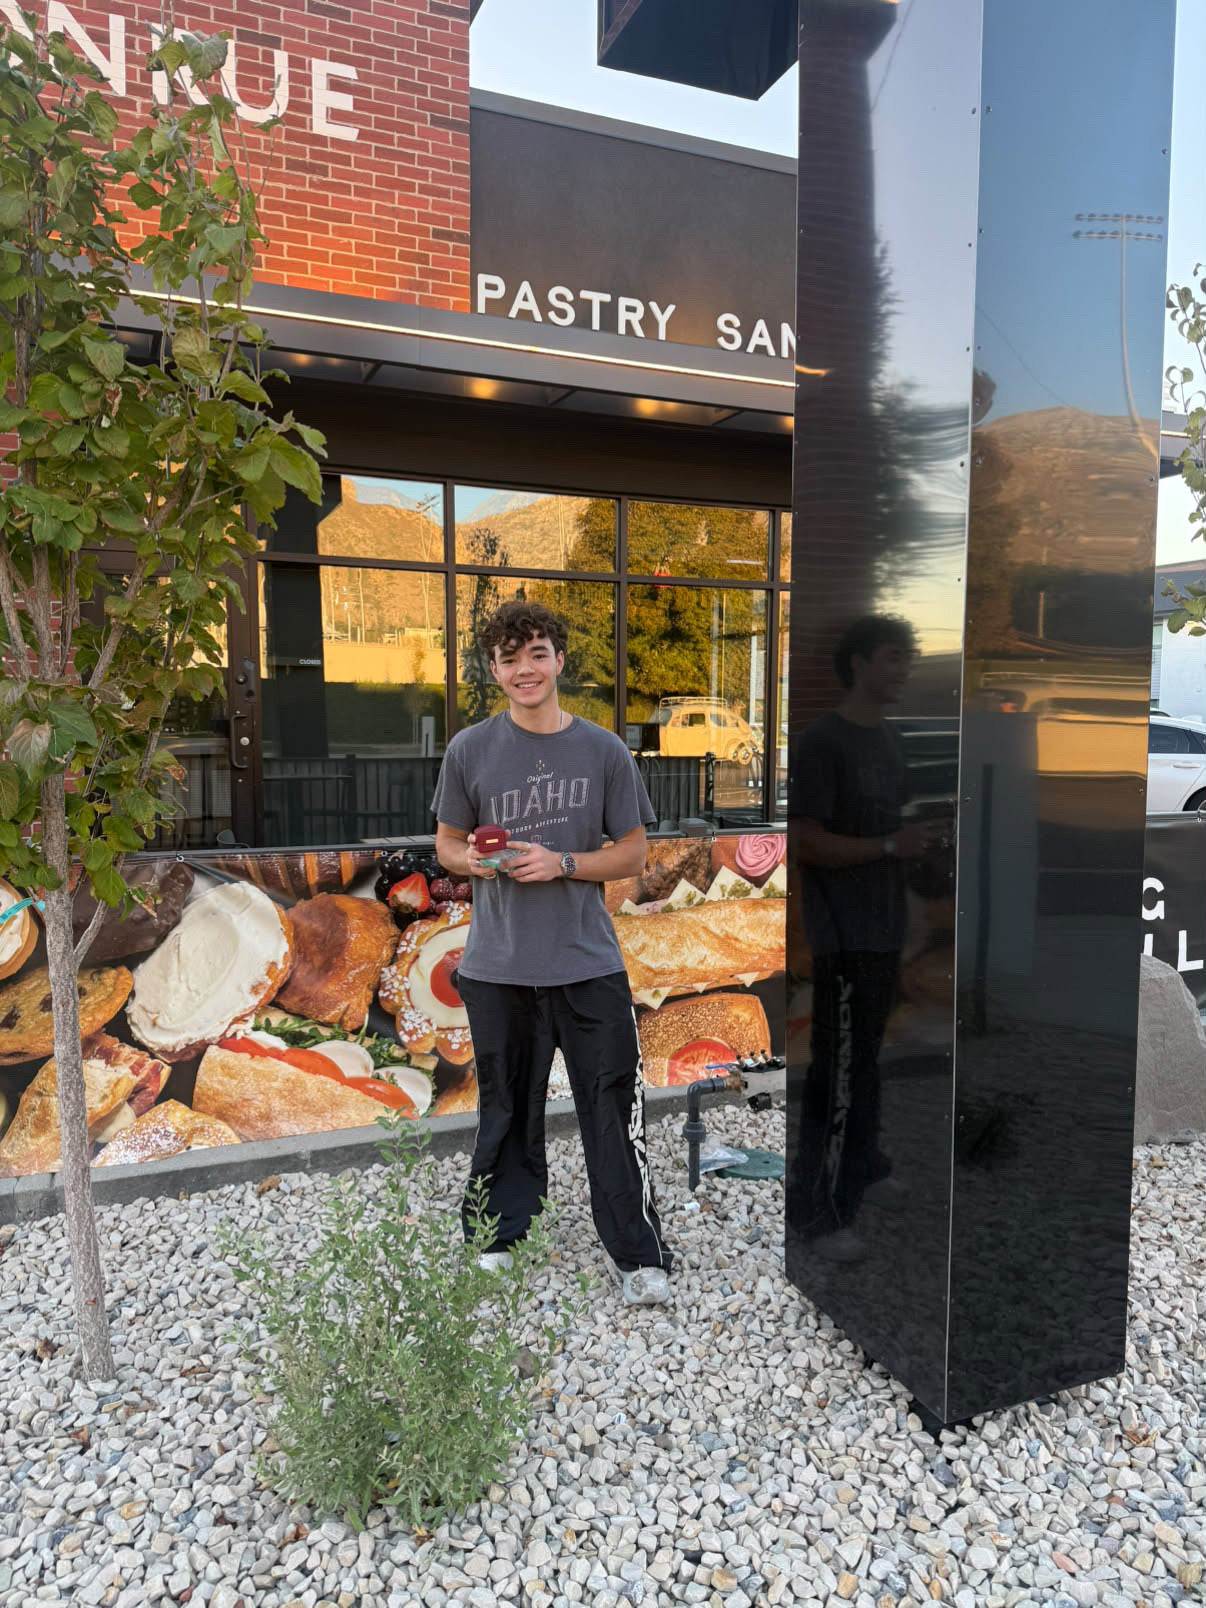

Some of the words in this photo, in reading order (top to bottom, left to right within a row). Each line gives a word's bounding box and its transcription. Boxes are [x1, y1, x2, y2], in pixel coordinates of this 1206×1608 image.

[477, 273, 676, 341] PASTRY
[526, 771, 554, 784] Original
[490, 778, 590, 826] IDAHO
